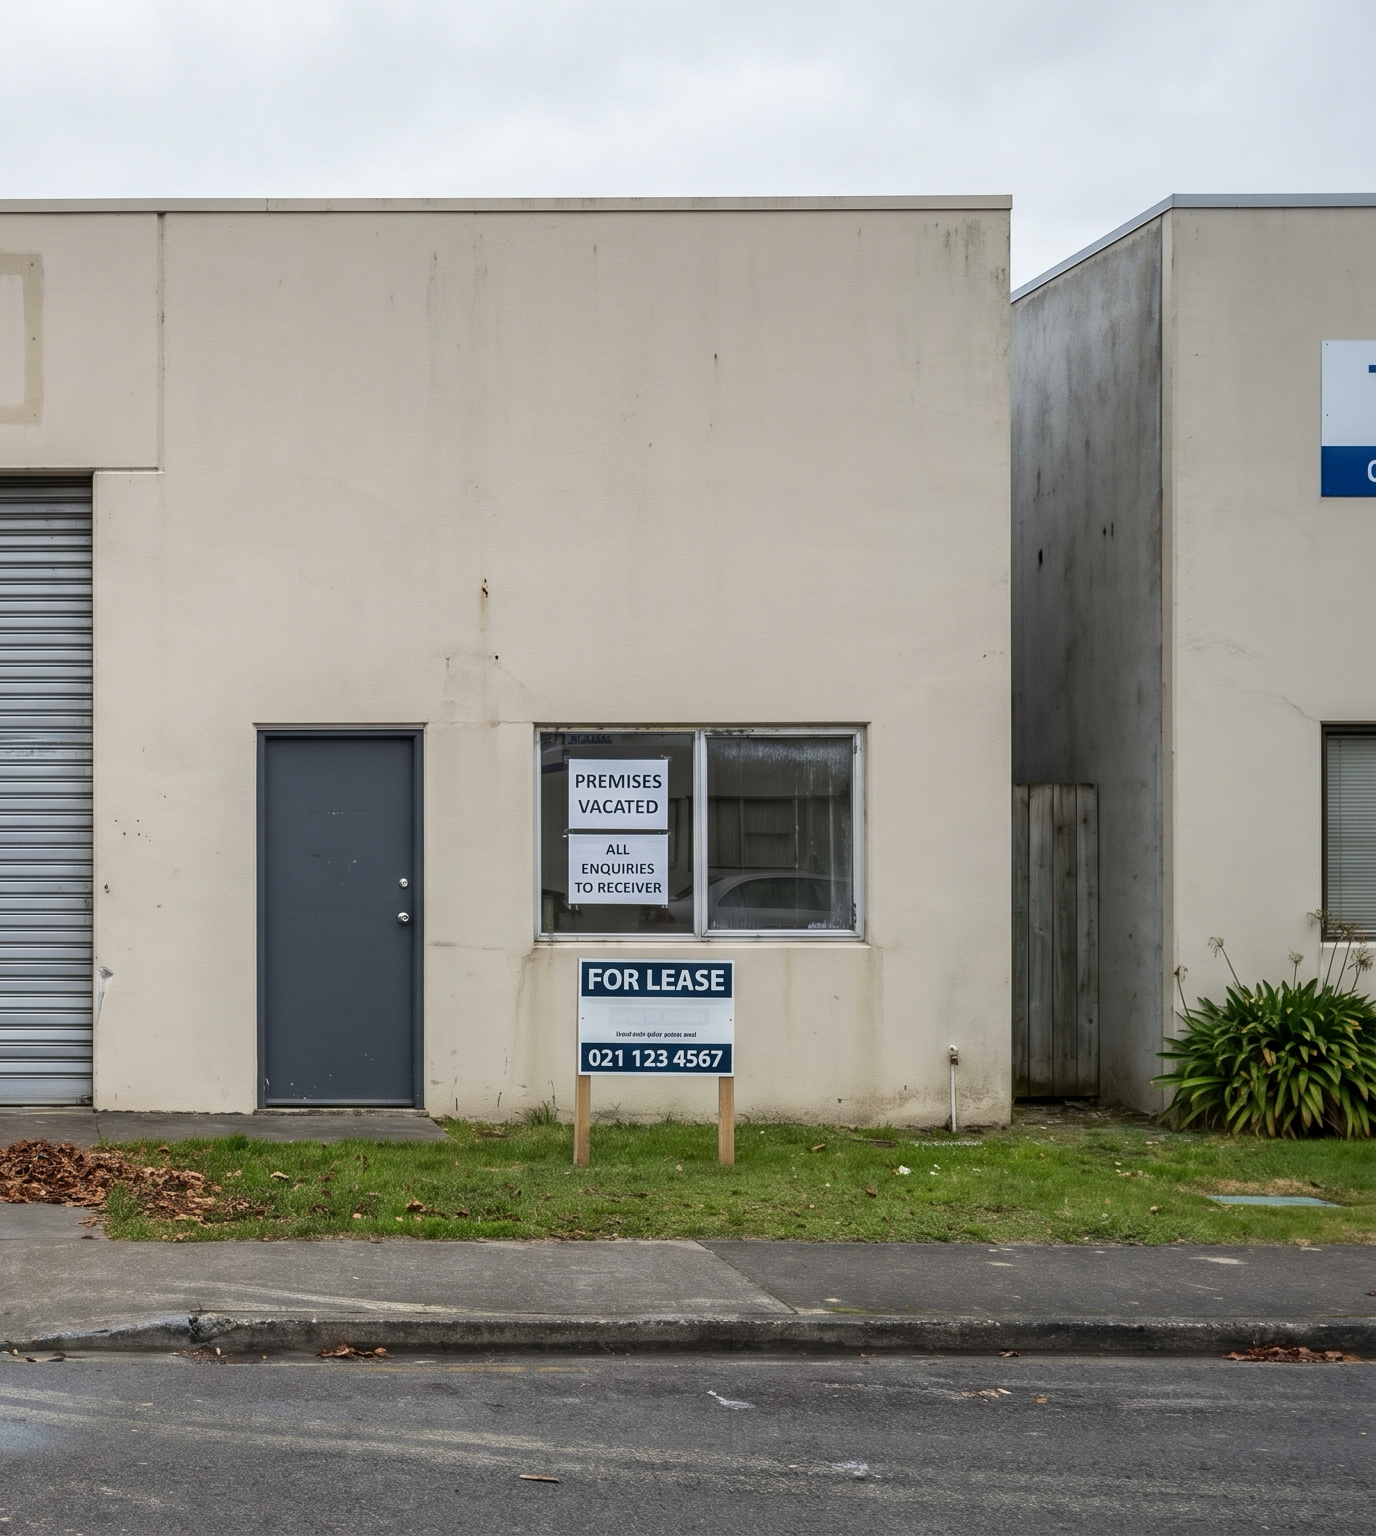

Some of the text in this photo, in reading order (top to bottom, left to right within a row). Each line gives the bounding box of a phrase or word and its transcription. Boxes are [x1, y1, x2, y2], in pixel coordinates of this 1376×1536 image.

[575, 773, 662, 789] PREMISES
[578, 799, 659, 814] VACATED
[605, 843, 630, 855] ALL
[581, 863, 655, 876] ENQUIRIES
[574, 882, 662, 894] TO RECEIVER
[588, 968, 725, 992] FOR LEASE
[588, 1048, 724, 1068] 021 123 4567
